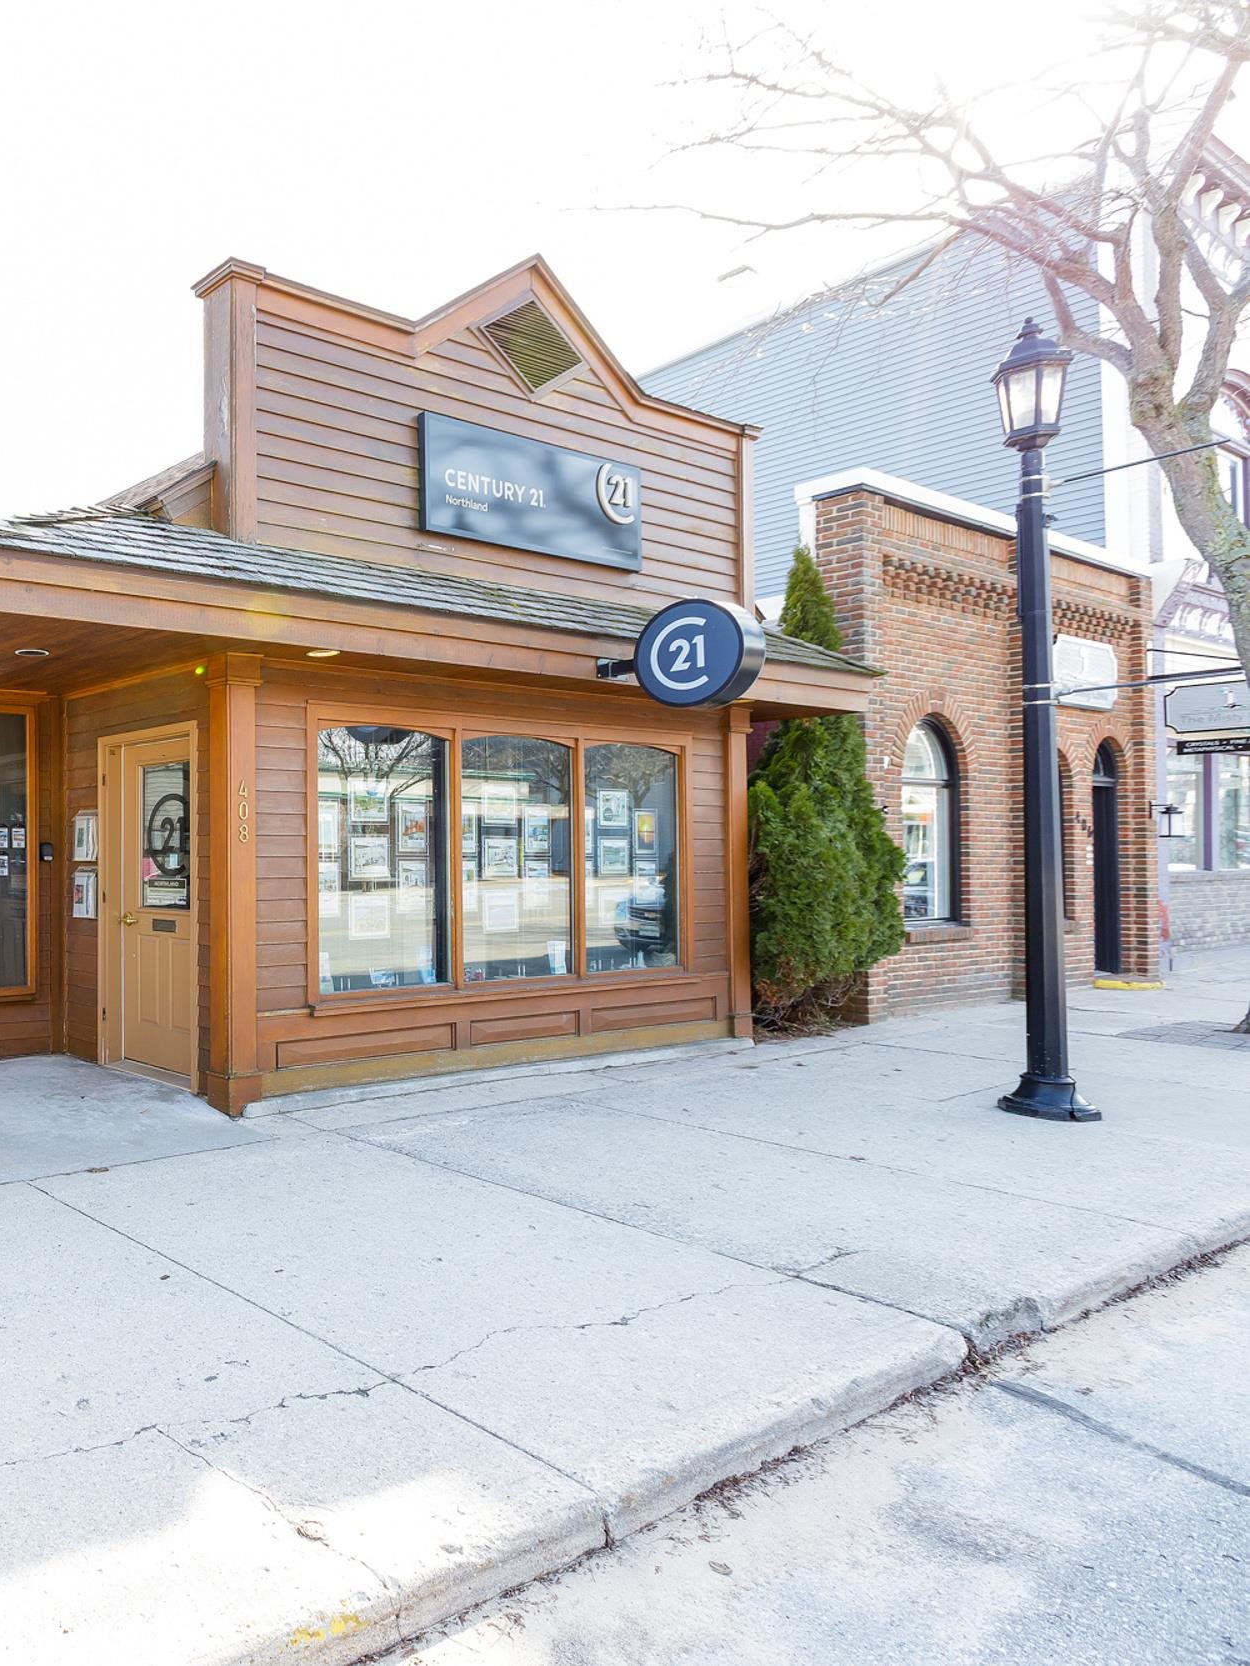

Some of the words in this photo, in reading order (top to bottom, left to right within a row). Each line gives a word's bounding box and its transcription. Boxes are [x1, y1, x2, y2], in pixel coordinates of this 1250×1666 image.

[444, 468, 526, 504] CENTURY
[445, 494, 489, 513] Northland
[237, 779, 250, 843] 408
